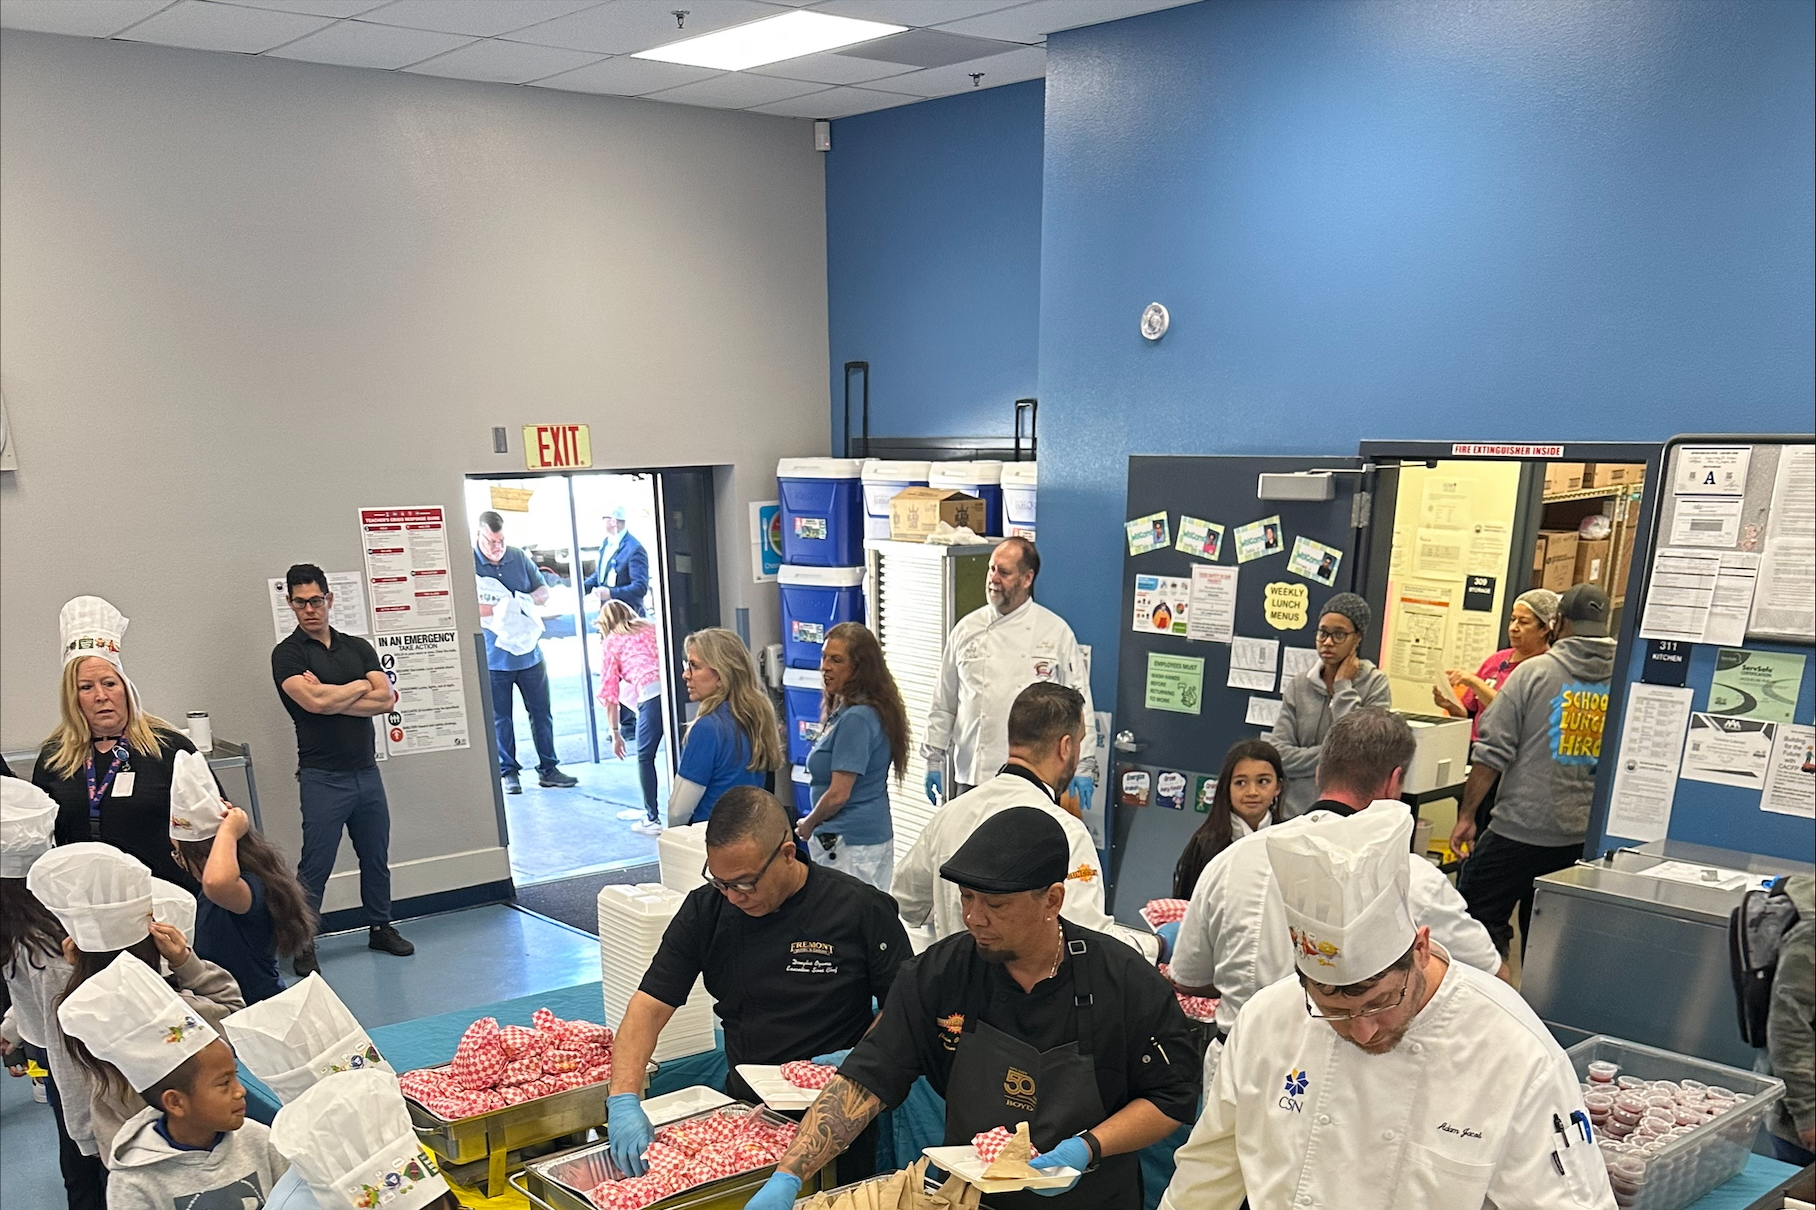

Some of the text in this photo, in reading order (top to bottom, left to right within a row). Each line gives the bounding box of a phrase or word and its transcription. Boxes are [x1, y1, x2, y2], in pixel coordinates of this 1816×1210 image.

[537, 426, 579, 467] EXIT
[1455, 446, 1560, 455] FIRE EXTINGUISHER INSIDE
[1703, 471, 1716, 485] A
[1474, 577, 1488, 586] 309
[1271, 587, 1304, 597] WEEKLY
[1272, 599, 1301, 609] LUNCH
[1271, 611, 1300, 621] MENUS
[378, 632, 455, 647] IN AN EMERGENCY
[1659, 641, 1678, 651] 311
[1652, 654, 1682, 663] KITCHEN
[1742, 665, 1773, 673] ServSafe
[1561, 690, 1609, 712] SCHOO
[790, 941, 834, 954] FREMONT
[1003, 1069, 1036, 1096] 50
[1006, 1099, 1034, 1112] BOYD
[1278, 1096, 1303, 1113] CSN
[1437, 1122, 1459, 1135] Adam
